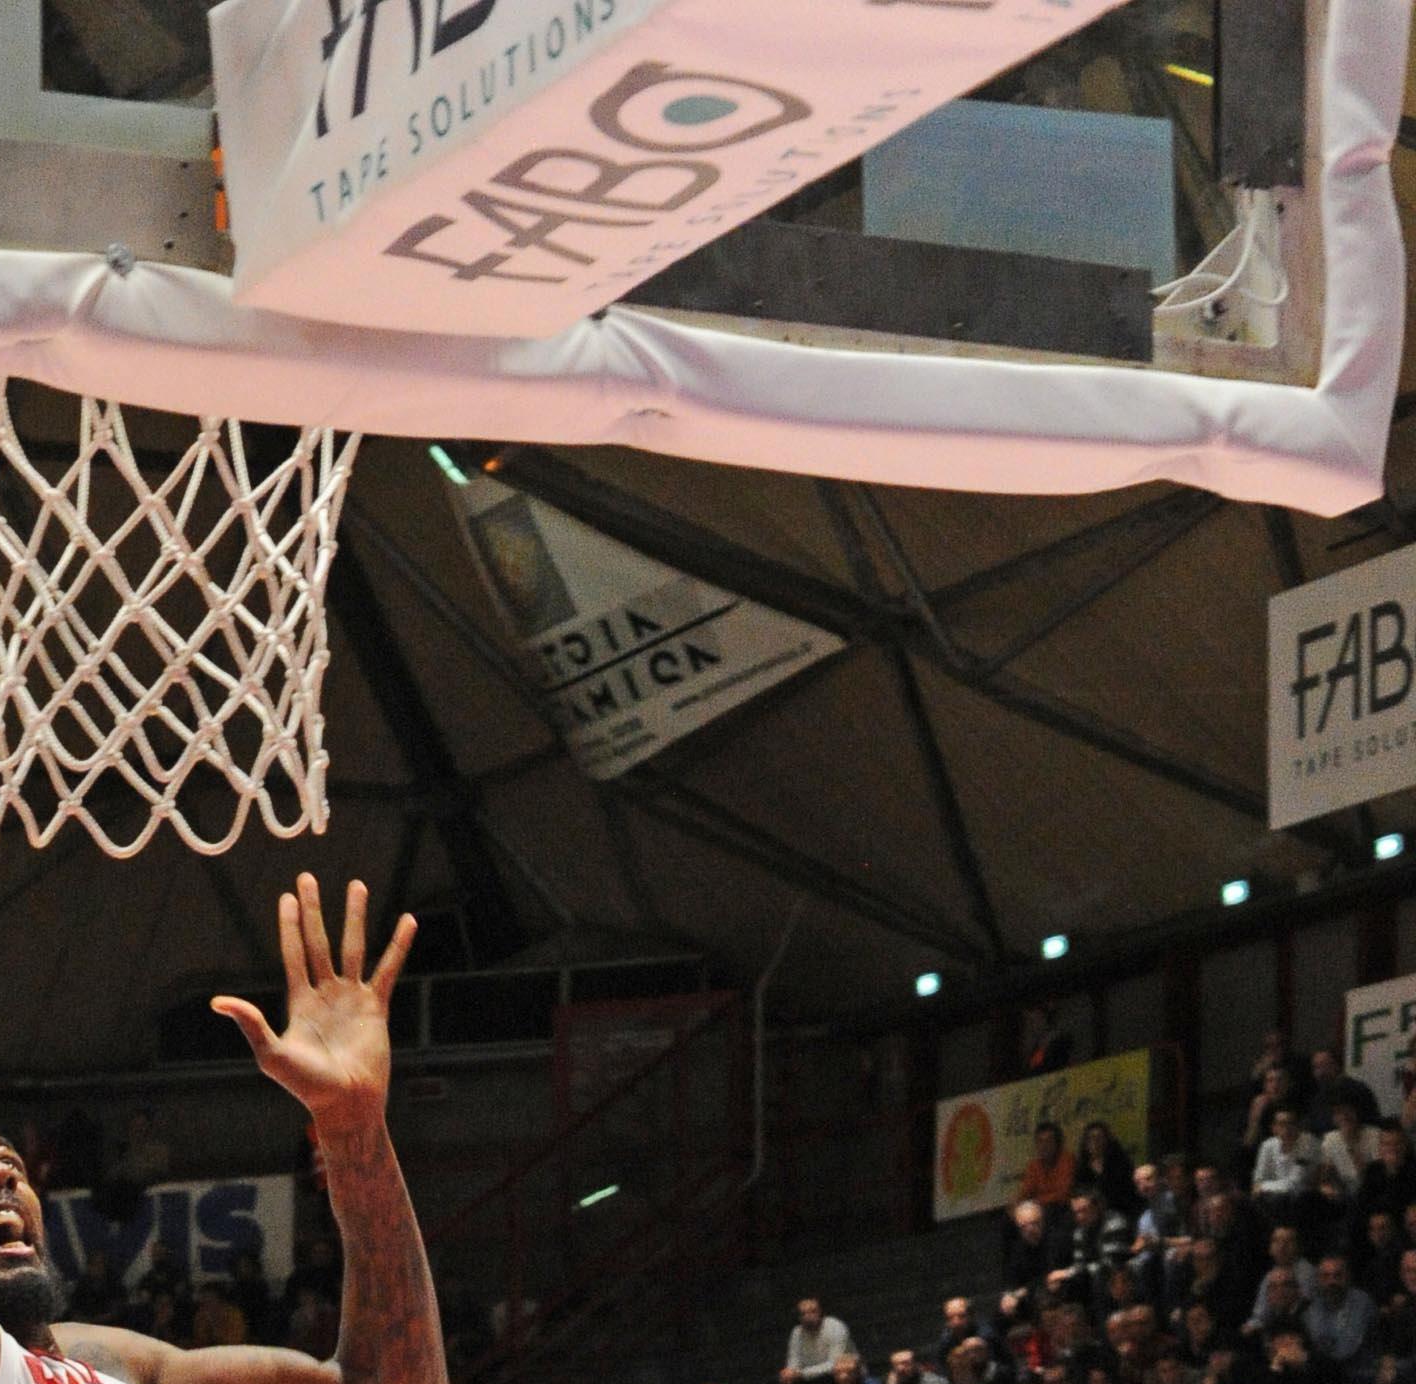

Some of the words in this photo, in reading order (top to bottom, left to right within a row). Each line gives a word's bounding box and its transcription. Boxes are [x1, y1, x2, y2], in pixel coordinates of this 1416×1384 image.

[311, 136, 390, 222] TAPE
[408, 0, 615, 155] SOLUTIONS
[383, 60, 814, 284] FABO
[1292, 601, 1416, 741] FAB
[46, 1184, 266, 1290] VIS
